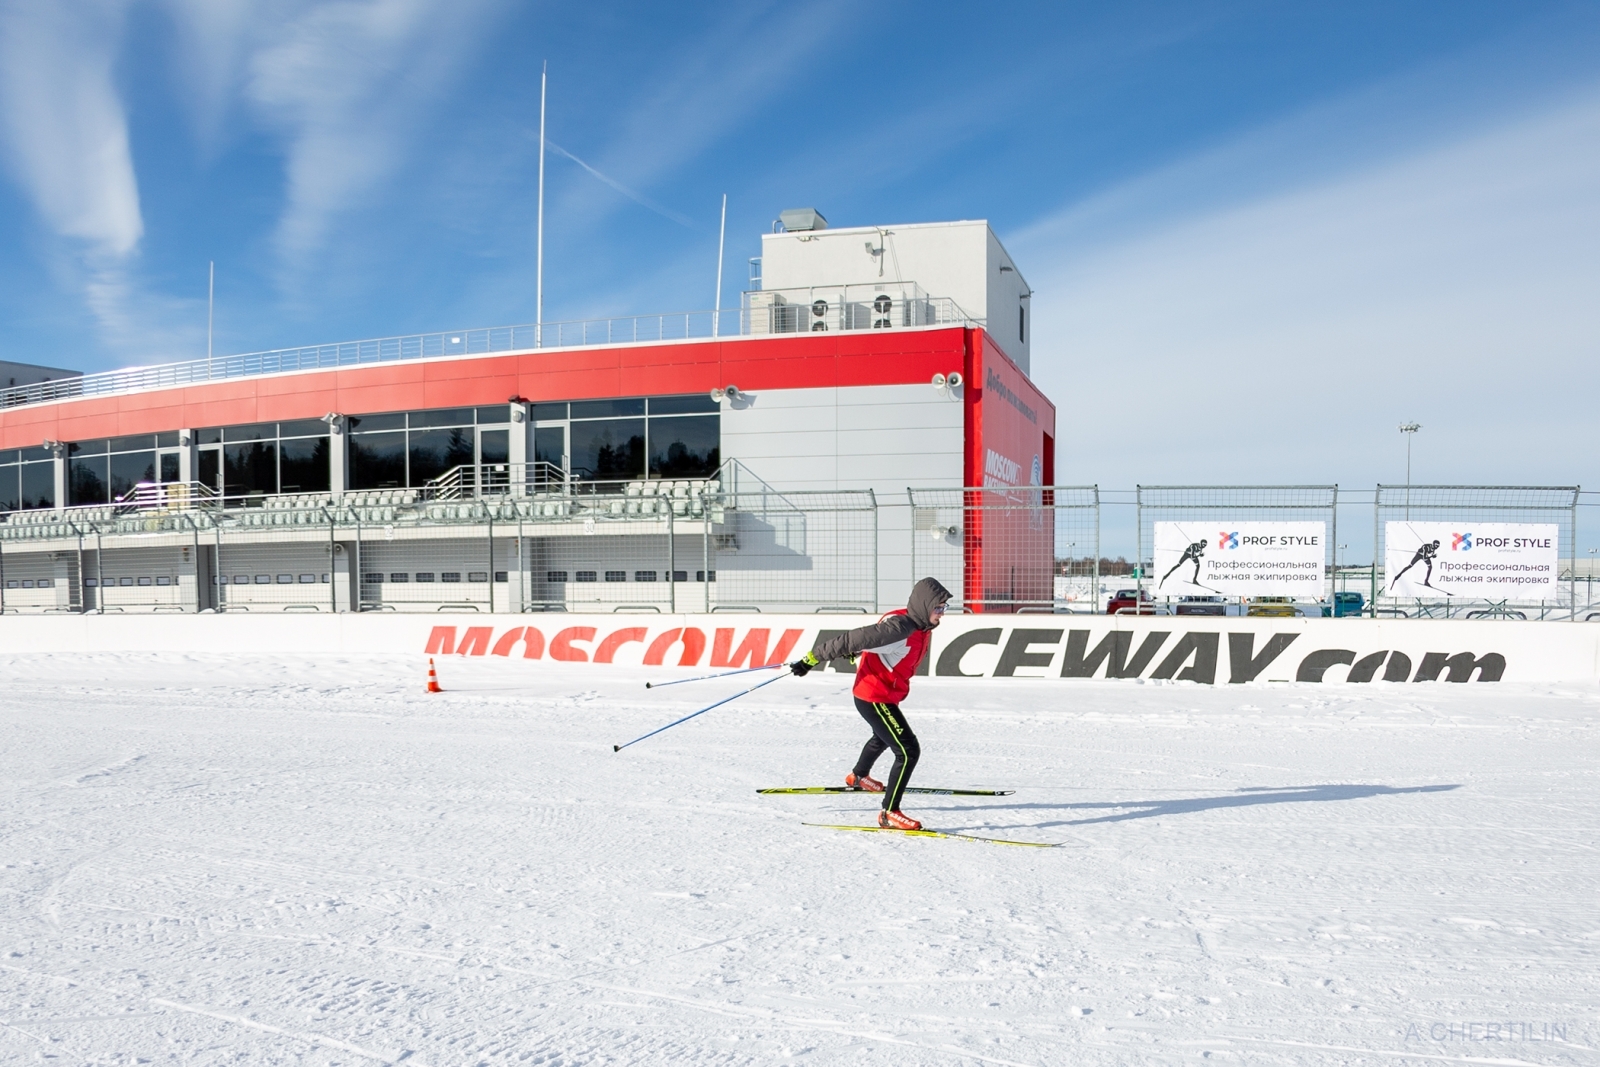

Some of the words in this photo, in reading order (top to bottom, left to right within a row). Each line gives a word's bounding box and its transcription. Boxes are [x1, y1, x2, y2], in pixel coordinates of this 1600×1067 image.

[985, 448, 1018, 485] MOSCOW
[1242, 536, 1277, 546] PROF
[1280, 536, 1319, 546] STYLE
[1476, 537, 1510, 548] PROF
[1513, 538, 1551, 548] STYLE
[1207, 560, 1318, 571] Профессиональная
[1440, 561, 1550, 572] Профессиональная
[1207, 573, 1251, 581] лыжная
[1253, 573, 1317, 583] экипировка
[1439, 575, 1483, 583] лыжная
[1486, 576, 1549, 586] экипировка
